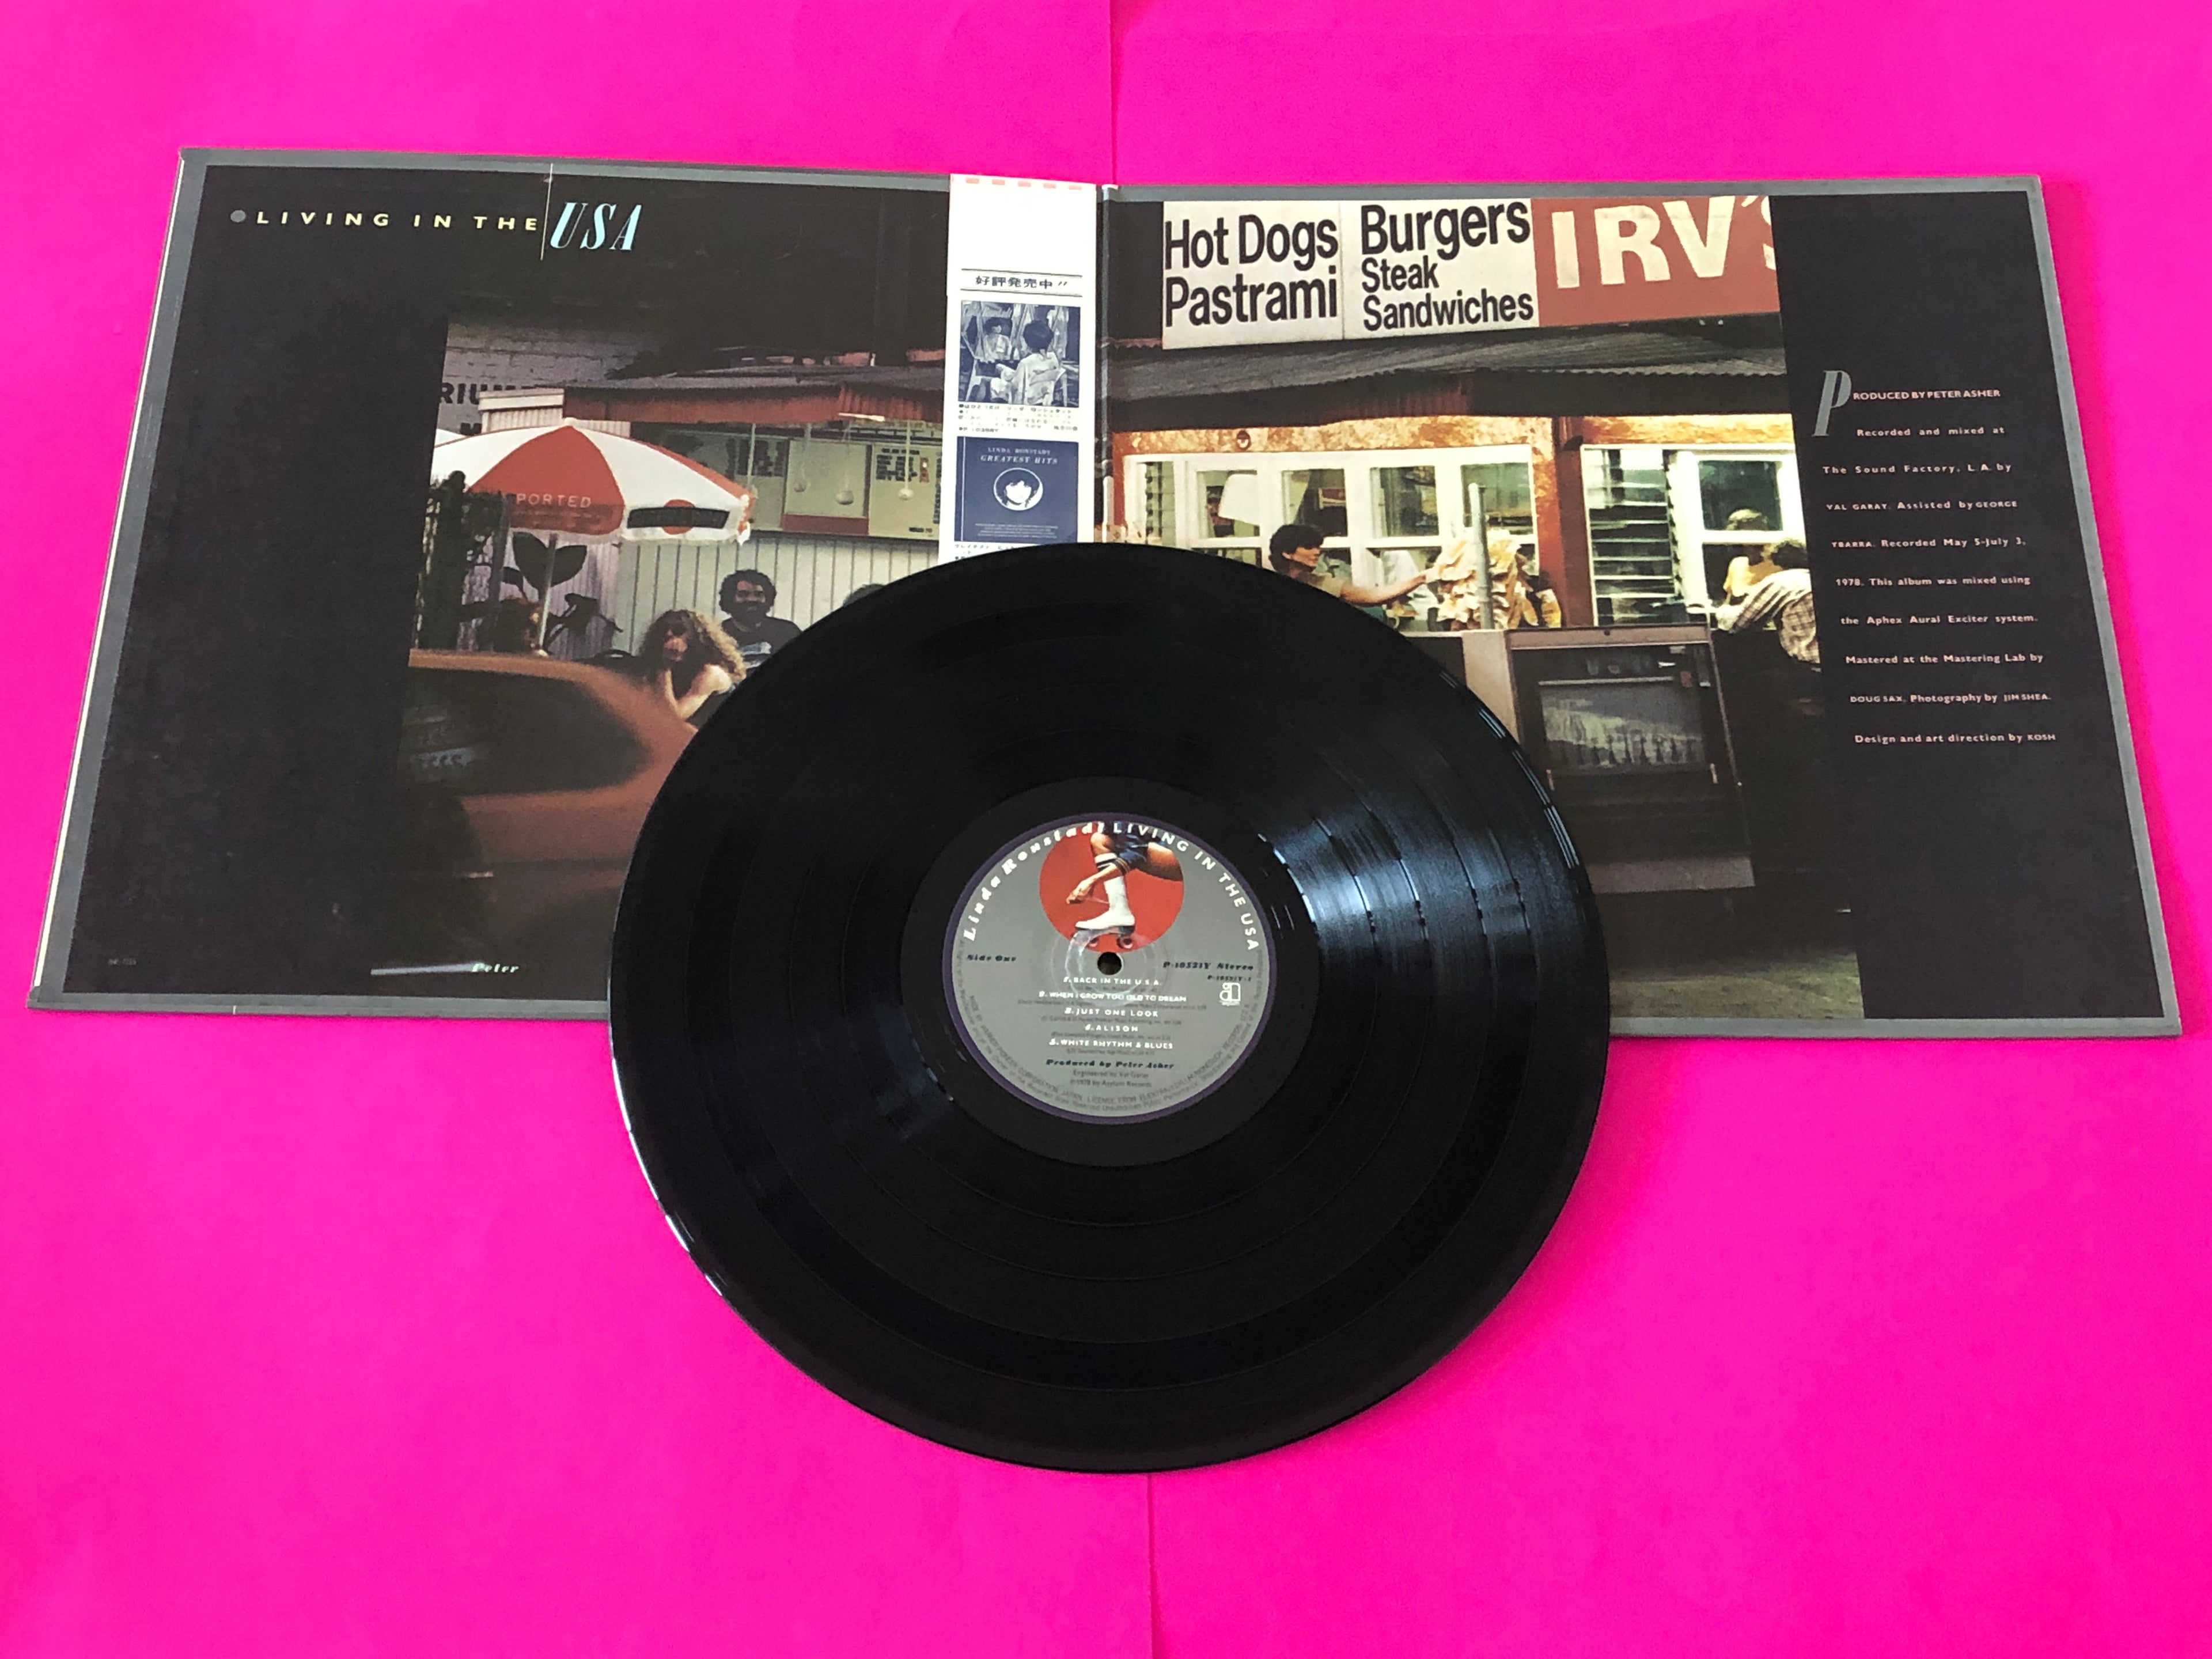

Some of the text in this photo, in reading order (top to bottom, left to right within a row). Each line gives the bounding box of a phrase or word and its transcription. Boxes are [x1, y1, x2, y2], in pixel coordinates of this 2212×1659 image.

[257, 202, 643, 252] LIVING IN THE USA
[1361, 200, 1532, 263] Burgers
[1165, 215, 1338, 271] Hot Dogs
[1362, 253, 1441, 295] Steak
[1165, 264, 1337, 327] Pastrami
[1363, 287, 1536, 334] Sandwiches
[1911, 391, 1927, 399] BY
[1927, 391, 1962, 399] PETER
[1964, 389, 2001, 397] ASHER
[1997, 463, 2012, 472] by
[516, 493, 592, 509] PORTED
[1959, 501, 1972, 510] by
[1944, 539, 1967, 547] May
[1974, 537, 2008, 547] 5-July
[2002, 577, 2030, 585] using
[1867, 616, 1902, 626] Aphex
[1995, 615, 2038, 624] system.
[1944, 655, 2000, 663] Mastering
[2030, 654, 2043, 662] by
[1911, 694, 1981, 704] Photography
[1984, 694, 1997, 703] by
[1855, 736, 1895, 744] Design
[2009, 734, 2022, 743] by
[963, 821, 1104, 941] Linda Ronstadt
[1113, 822, 1259, 950] LIVING IN THE USA
[471, 963, 519, 974] Peter
